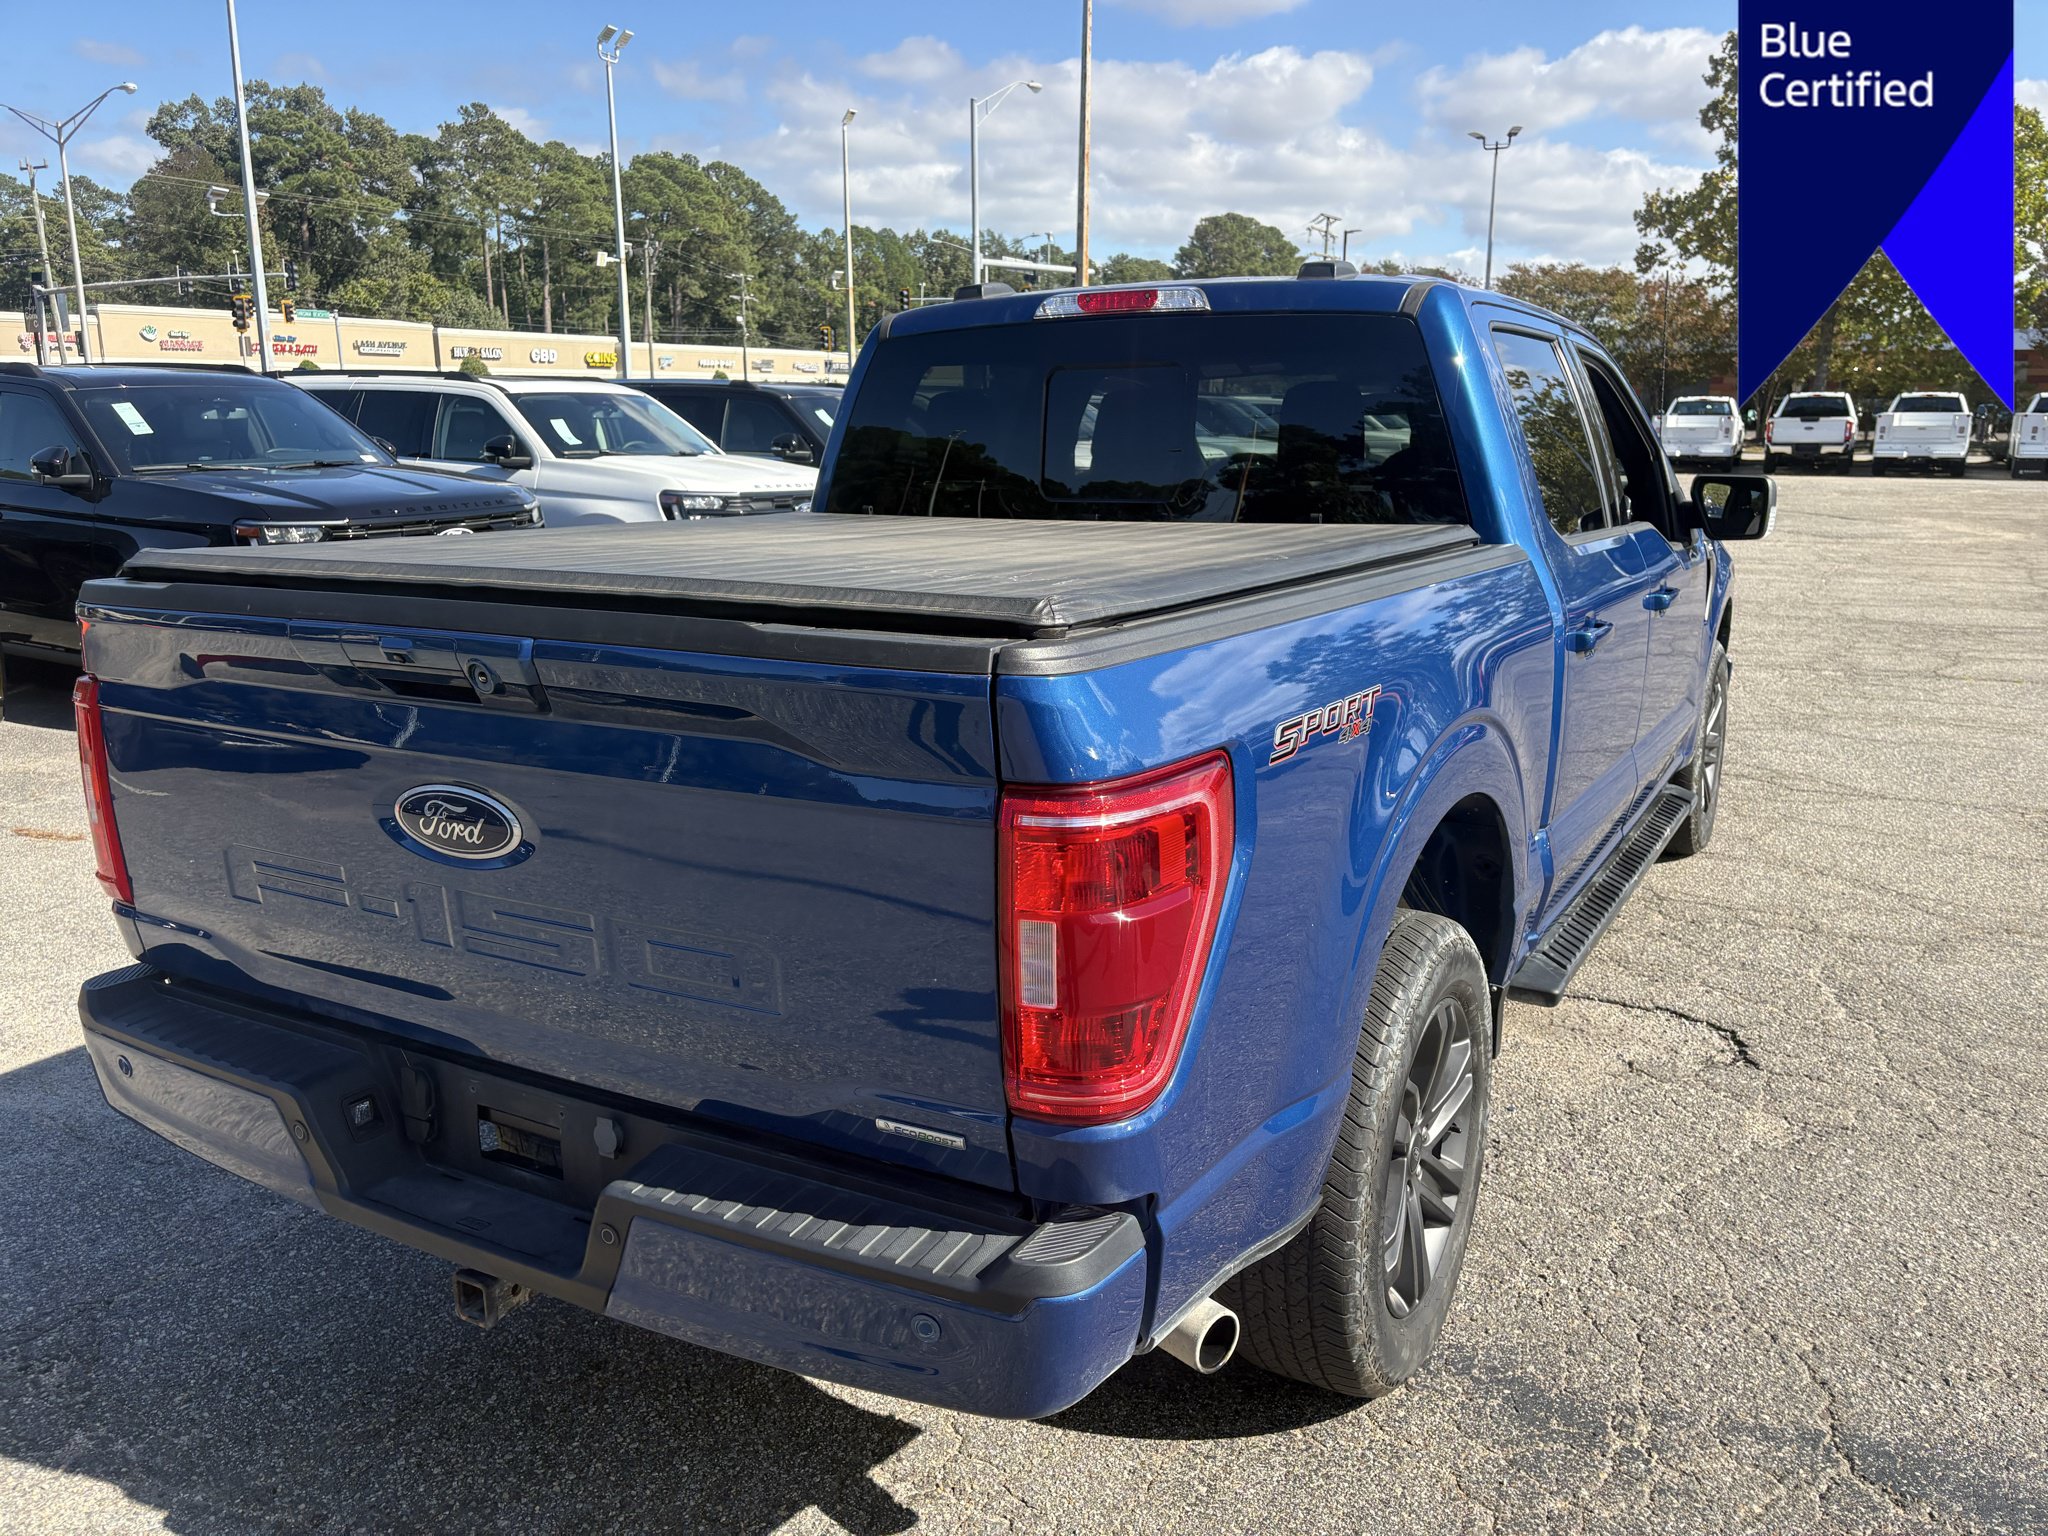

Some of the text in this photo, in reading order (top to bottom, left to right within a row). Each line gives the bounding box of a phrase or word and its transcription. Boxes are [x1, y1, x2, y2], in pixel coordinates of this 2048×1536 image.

[1269, 684, 1382, 767] SPORT
[419, 799, 485, 845] Ford
[224, 842, 783, 1018] F-150
